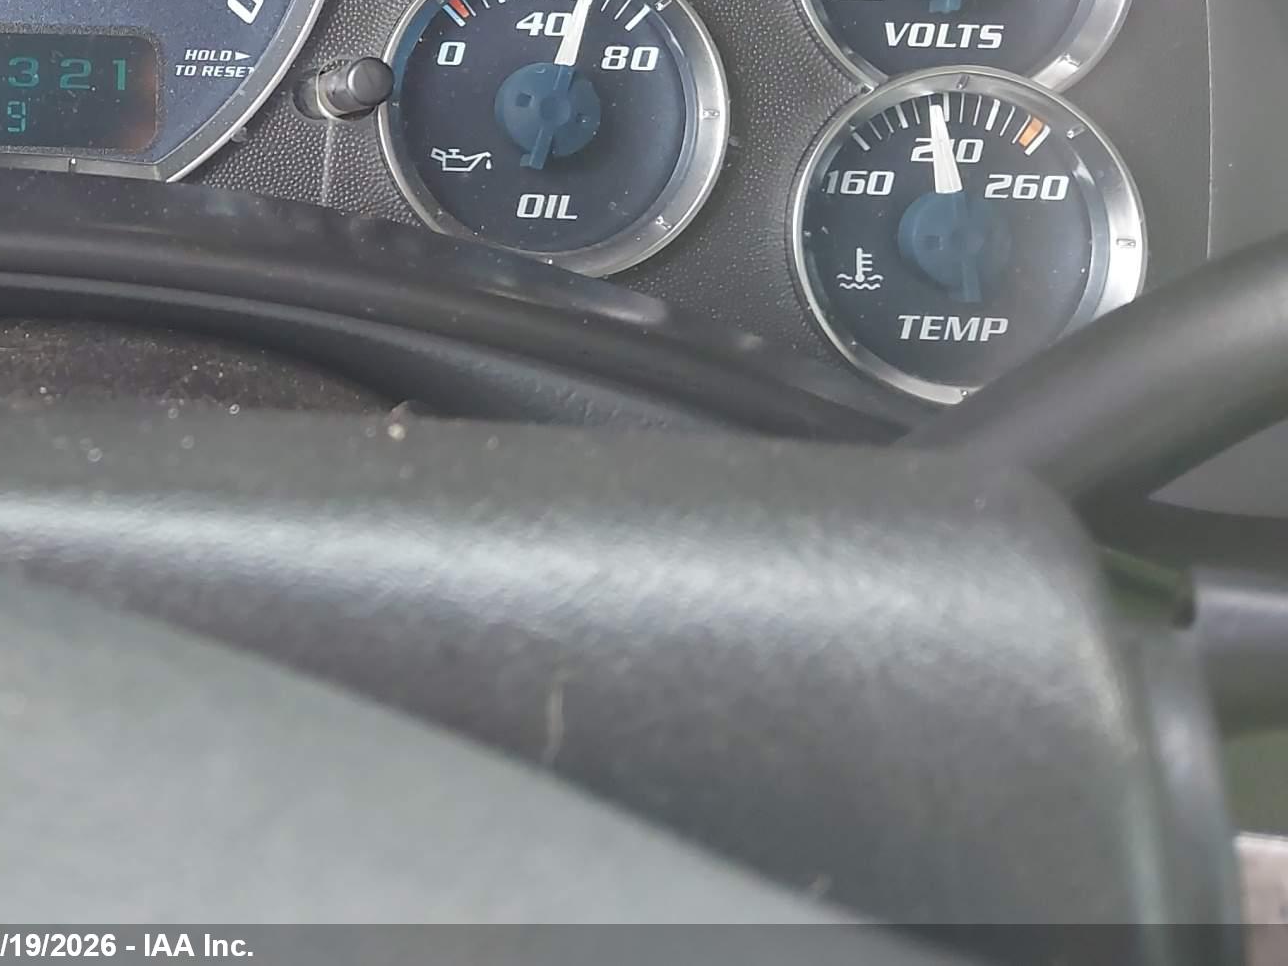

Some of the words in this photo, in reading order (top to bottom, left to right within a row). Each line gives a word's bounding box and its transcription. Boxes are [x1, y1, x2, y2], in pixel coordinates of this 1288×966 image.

[516, 12, 573, 36] 40
[885, 22, 1005, 50] VOLTS
[184, 49, 233, 62] HOLD
[437, 41, 467, 67] 0
[600, 46, 660, 72] 80
[8, 57, 41, 88] 3
[60, 58, 93, 90] 2
[112, 60, 127, 91] 1
[175, 65, 197, 76] TO
[910, 138, 984, 164] 20
[826, 170, 895, 196] 160
[984, 174, 1069, 201] 260
[516, 194, 578, 221] OIL
[898, 314, 1009, 342] TEMP
